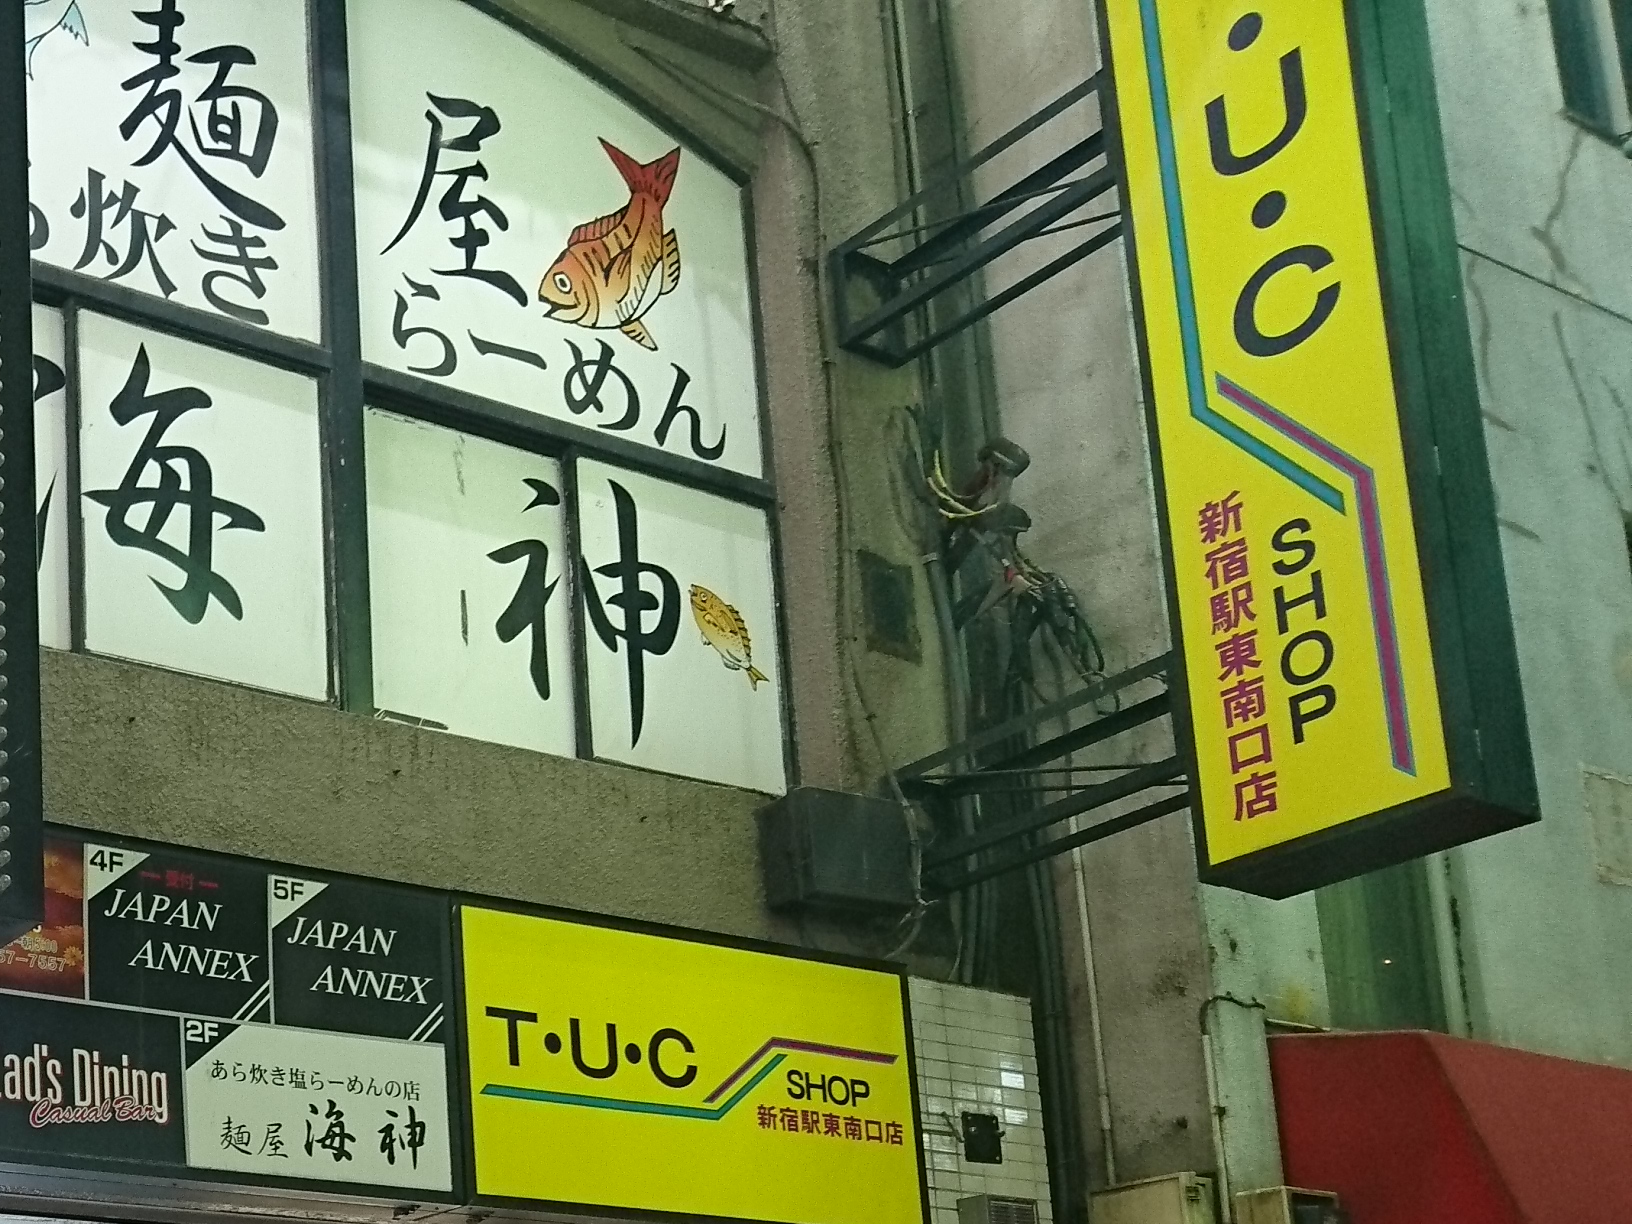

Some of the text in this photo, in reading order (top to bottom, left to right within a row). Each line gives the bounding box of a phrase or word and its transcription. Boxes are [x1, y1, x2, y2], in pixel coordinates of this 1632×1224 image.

[1272, 517, 1337, 744] SHOP
[1198, 489, 1279, 823] 新宿駅東南口店
[90, 850, 123, 872] 4F
[105, 889, 223, 931] JAPAN
[273, 880, 304, 901] 5F
[287, 917, 396, 958] JAPAN
[129, 939, 259, 982] ANNEX
[310, 965, 433, 1005] ANNEX
[186, 1020, 219, 1043] 2F
[74, 1049, 168, 1125] Dining
[210, 1060, 421, 1102] あら炊き塩らーめんの店
[787, 1069, 870, 1108] SHOP
[29, 1094, 155, 1129] Casual Bar
[757, 1104, 904, 1146] 新宿駅東南口店
